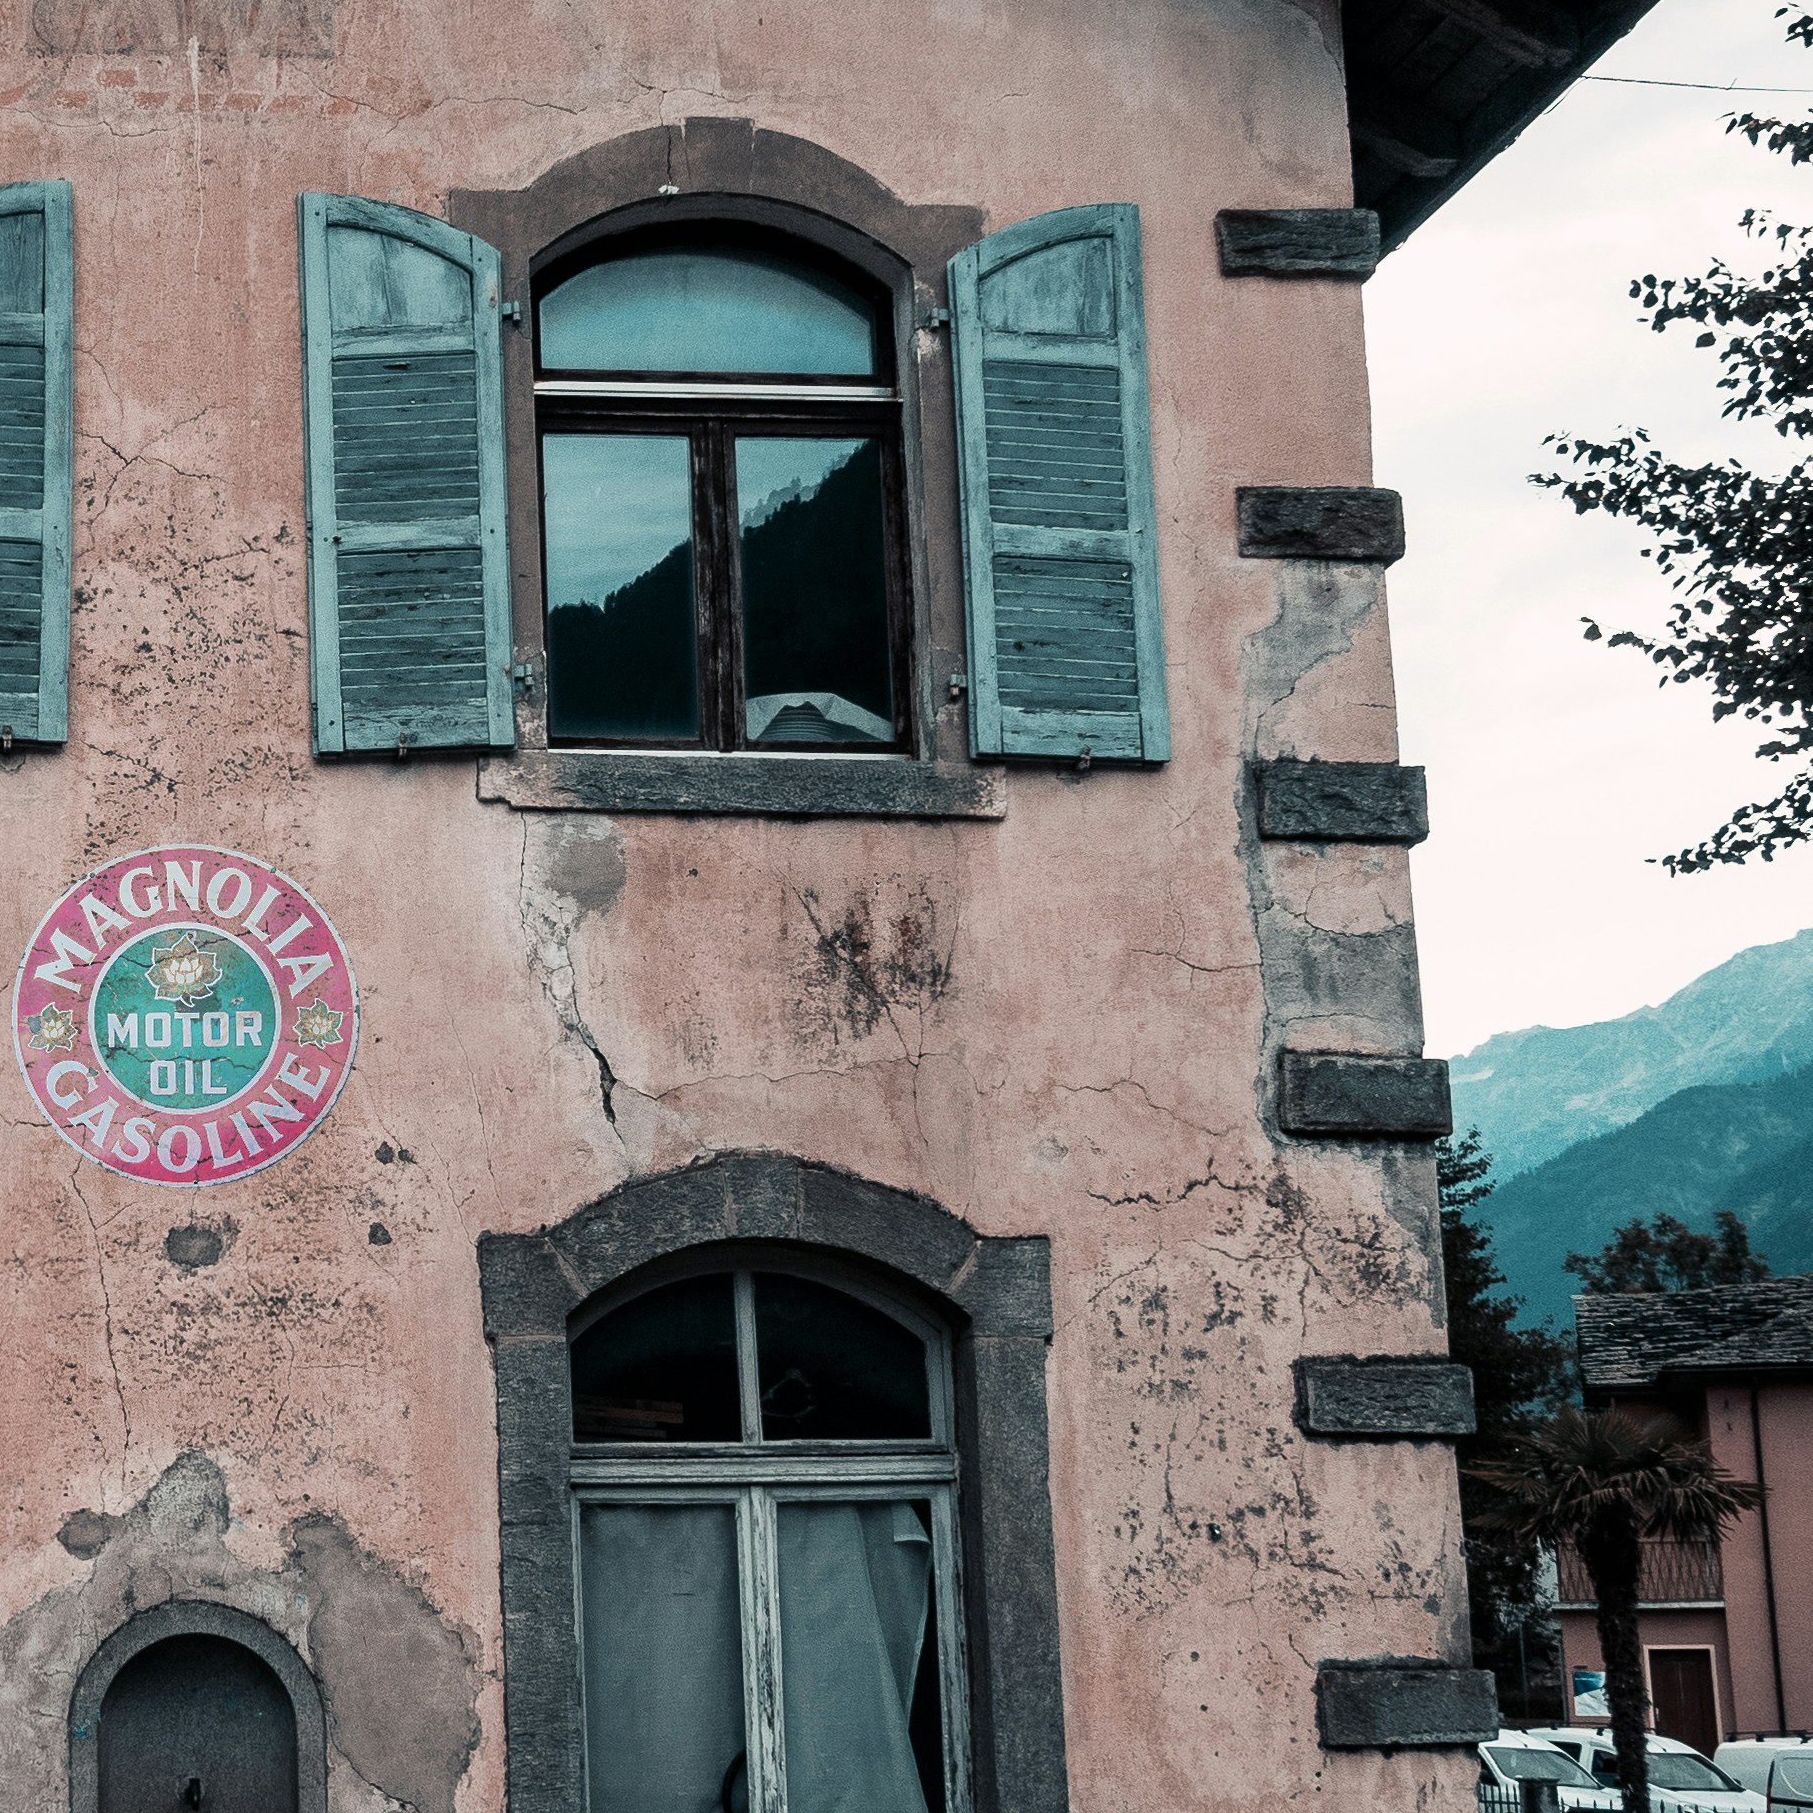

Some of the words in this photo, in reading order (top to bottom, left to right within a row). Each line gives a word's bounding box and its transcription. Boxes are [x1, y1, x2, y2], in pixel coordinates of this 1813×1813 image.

[34, 859, 334, 998] MAGNOLIA
[108, 1010, 263, 1048] MOTOR
[46, 1052, 331, 1173] GASOLINE
[149, 1060, 228, 1096] OIL
